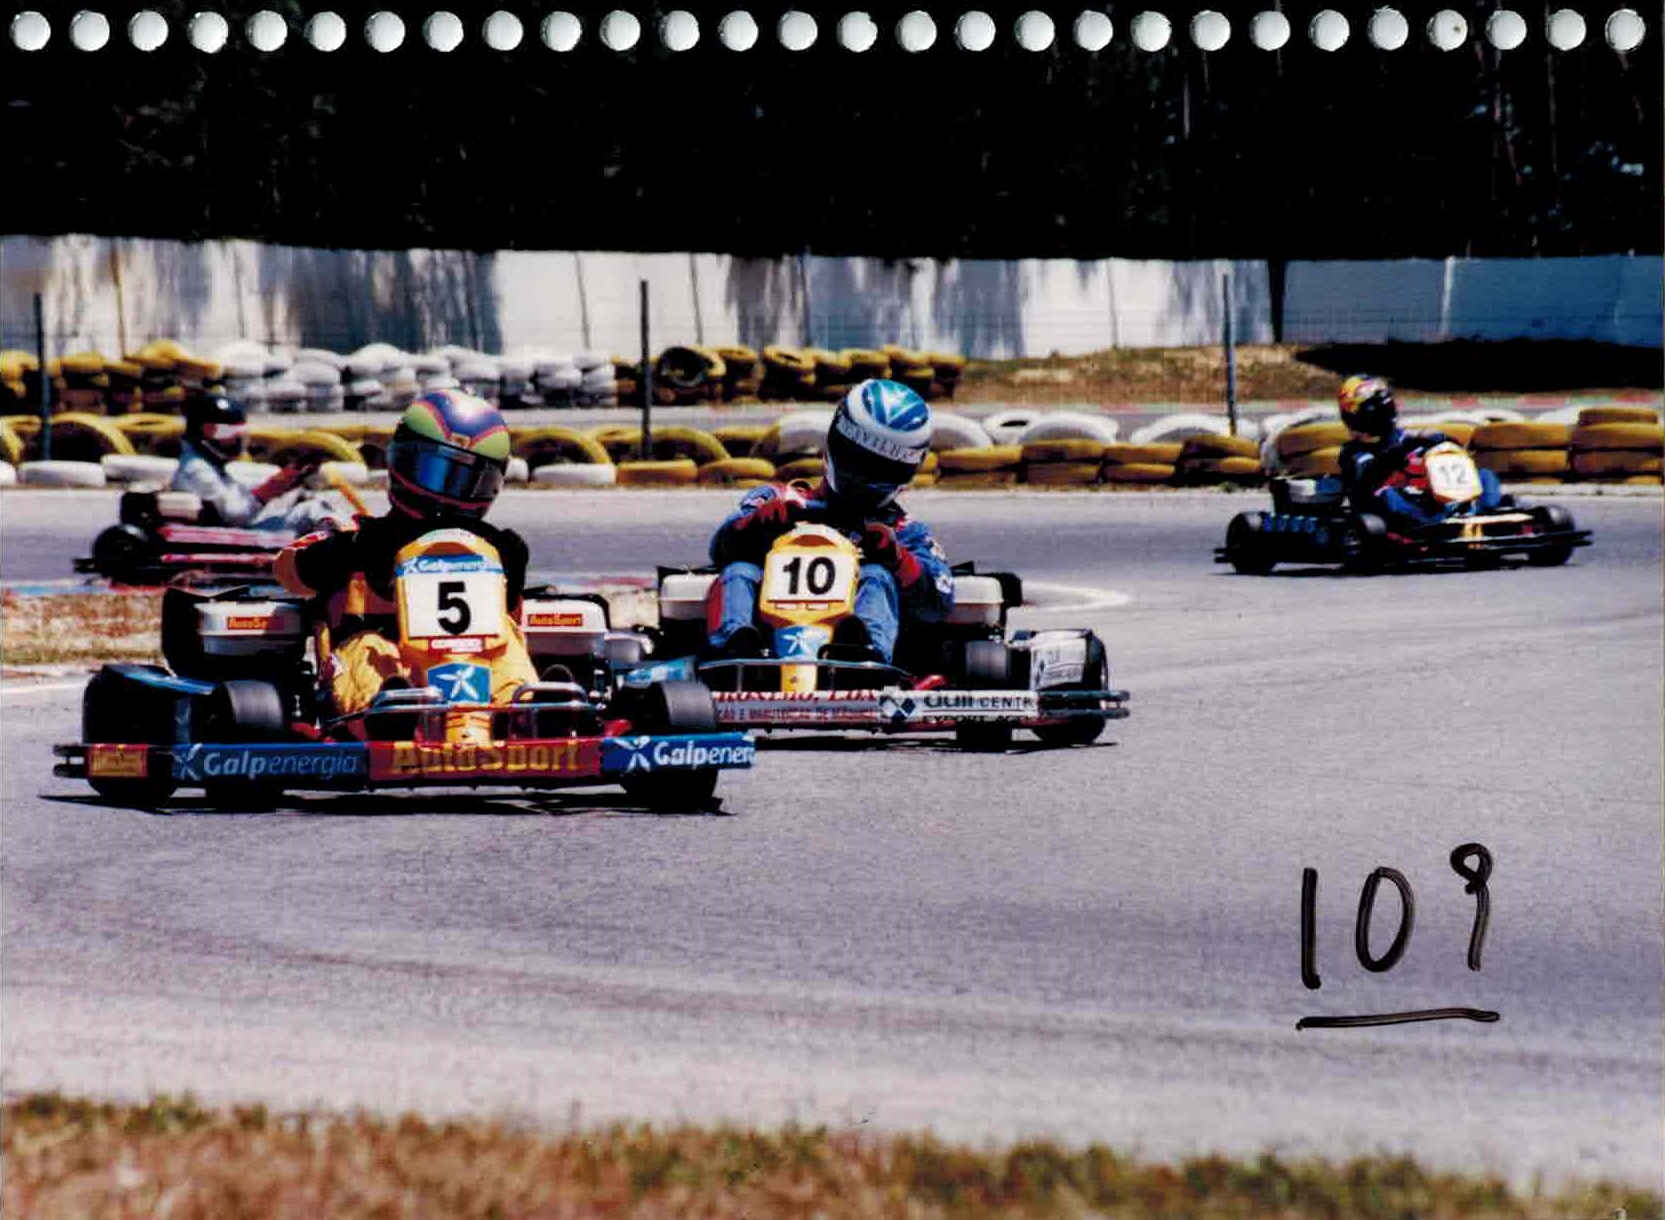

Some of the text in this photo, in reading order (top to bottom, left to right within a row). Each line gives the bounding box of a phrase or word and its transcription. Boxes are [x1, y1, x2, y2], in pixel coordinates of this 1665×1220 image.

[1440, 463, 1468, 484] 12
[783, 557, 836, 595] 10
[437, 581, 472, 636] 5
[203, 749, 356, 779] Galpenergia
